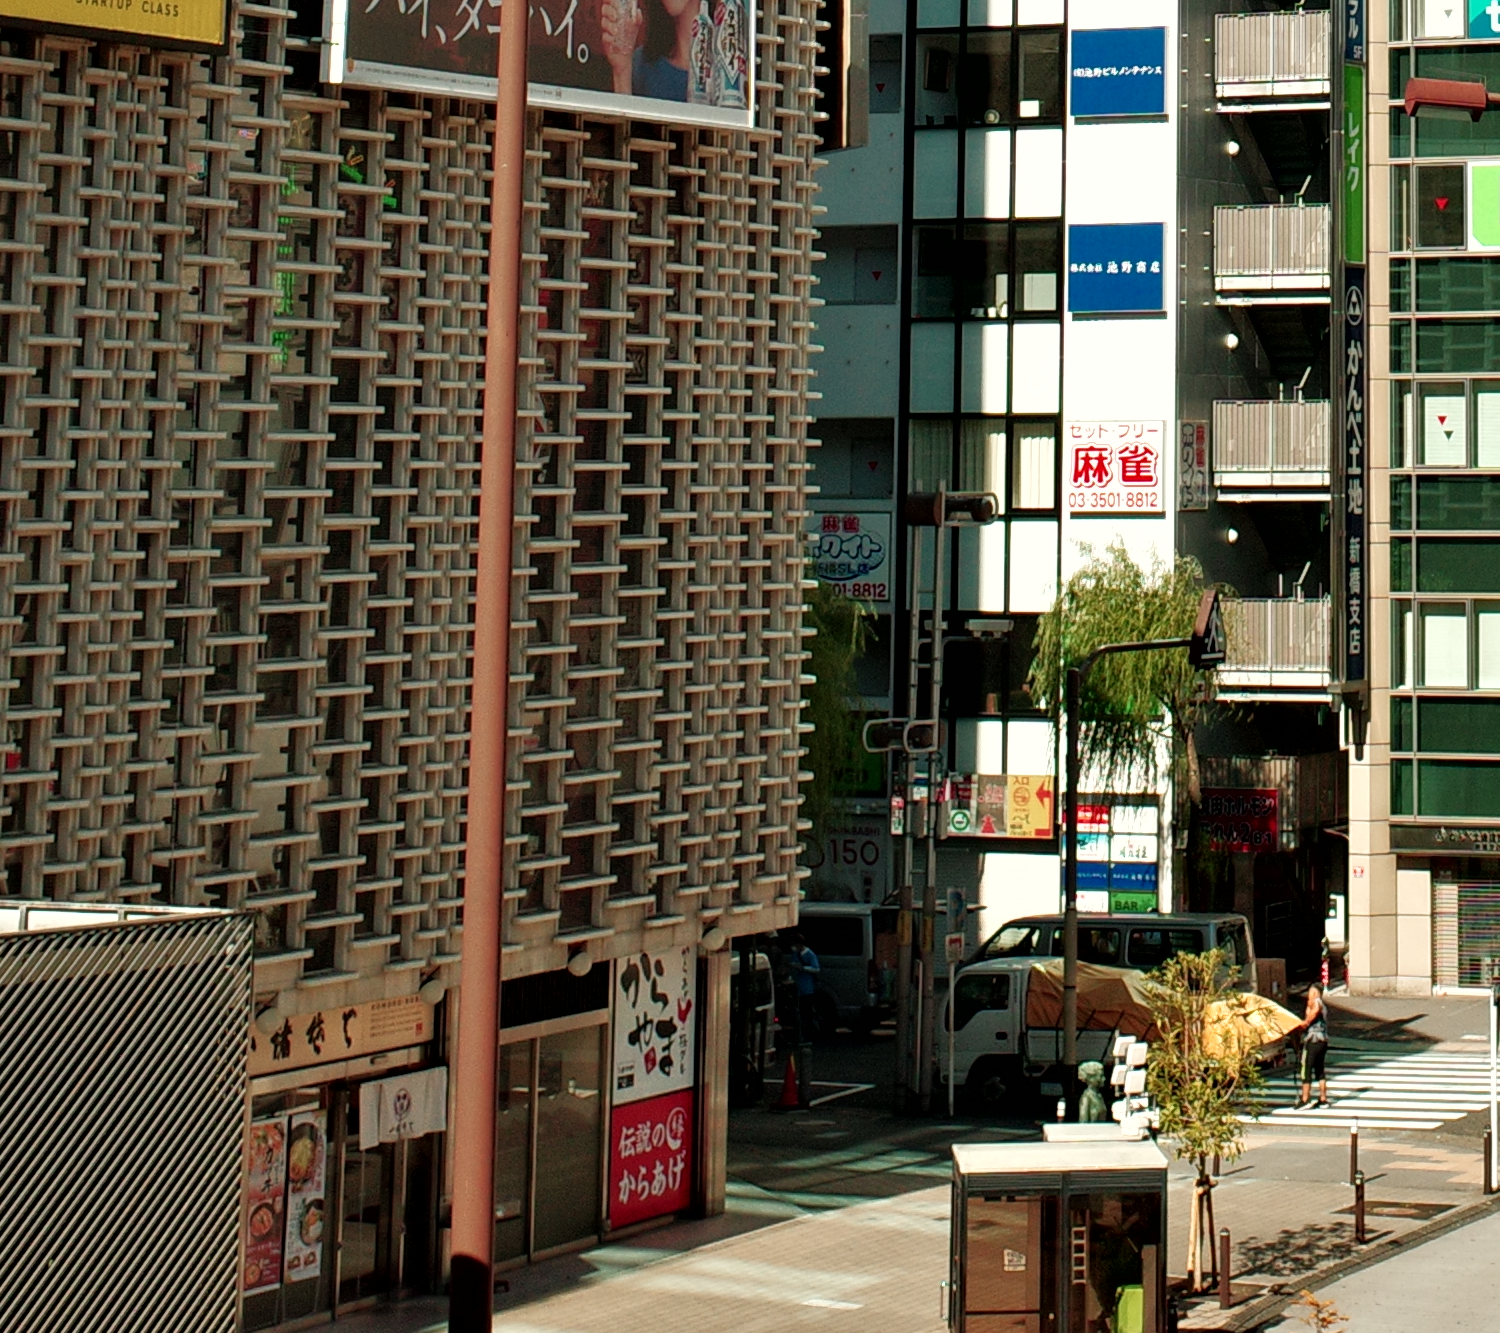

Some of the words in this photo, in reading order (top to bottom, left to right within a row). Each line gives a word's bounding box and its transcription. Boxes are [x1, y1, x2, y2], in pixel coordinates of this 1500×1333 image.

[1348, 112, 1360, 192] レイク
[1347, 340, 1362, 515] かんべ土地
[1073, 444, 1157, 484] 麻雀
[822, 514, 859, 532] 麻雀
[1114, 900, 1138, 911] BAR
[619, 1149, 686, 1204] からあげ
